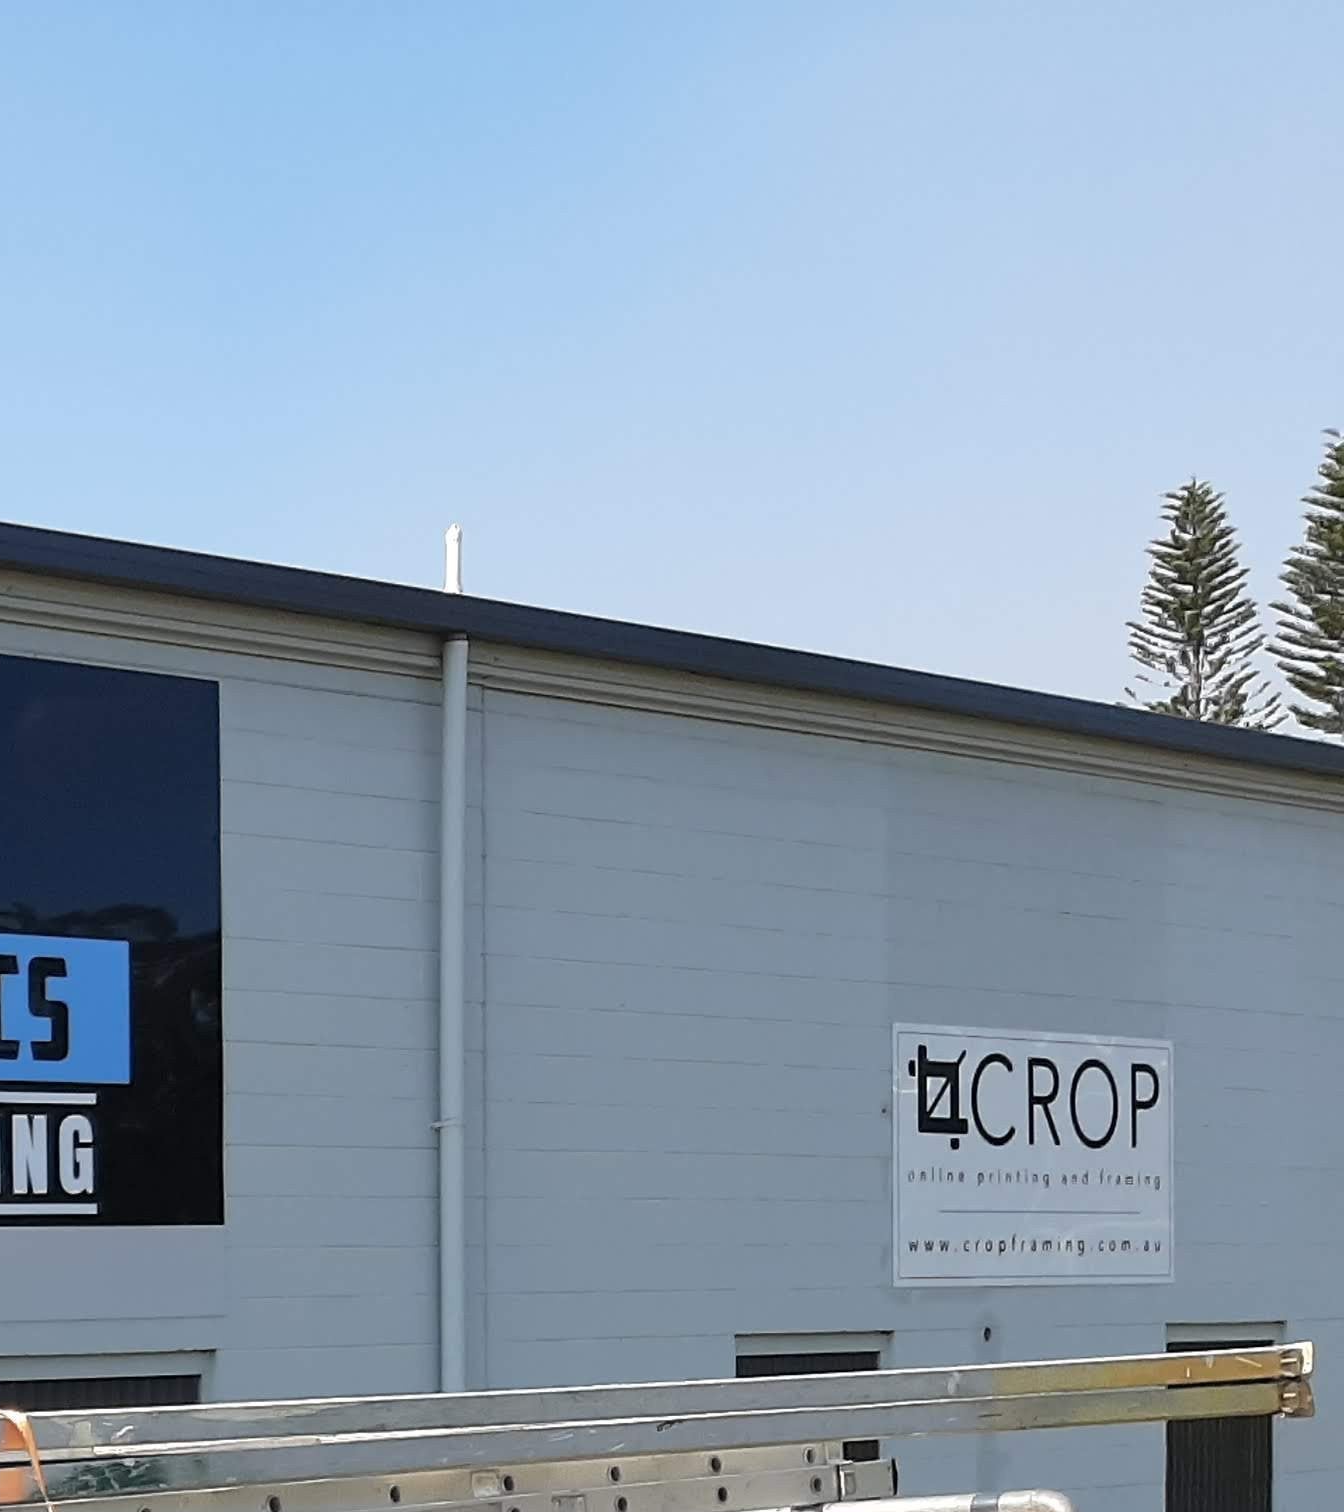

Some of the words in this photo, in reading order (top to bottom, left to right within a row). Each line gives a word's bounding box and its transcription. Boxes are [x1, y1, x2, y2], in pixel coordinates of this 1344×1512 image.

[971, 1053, 1159, 1148] CROP
[908, 1168, 965, 1184] online
[977, 1168, 1050, 1187] printing
[1061, 1170, 1089, 1185] and
[1100, 1168, 1161, 1190] framing
[908, 1234, 1161, 1256] www.cropframing.com.au
